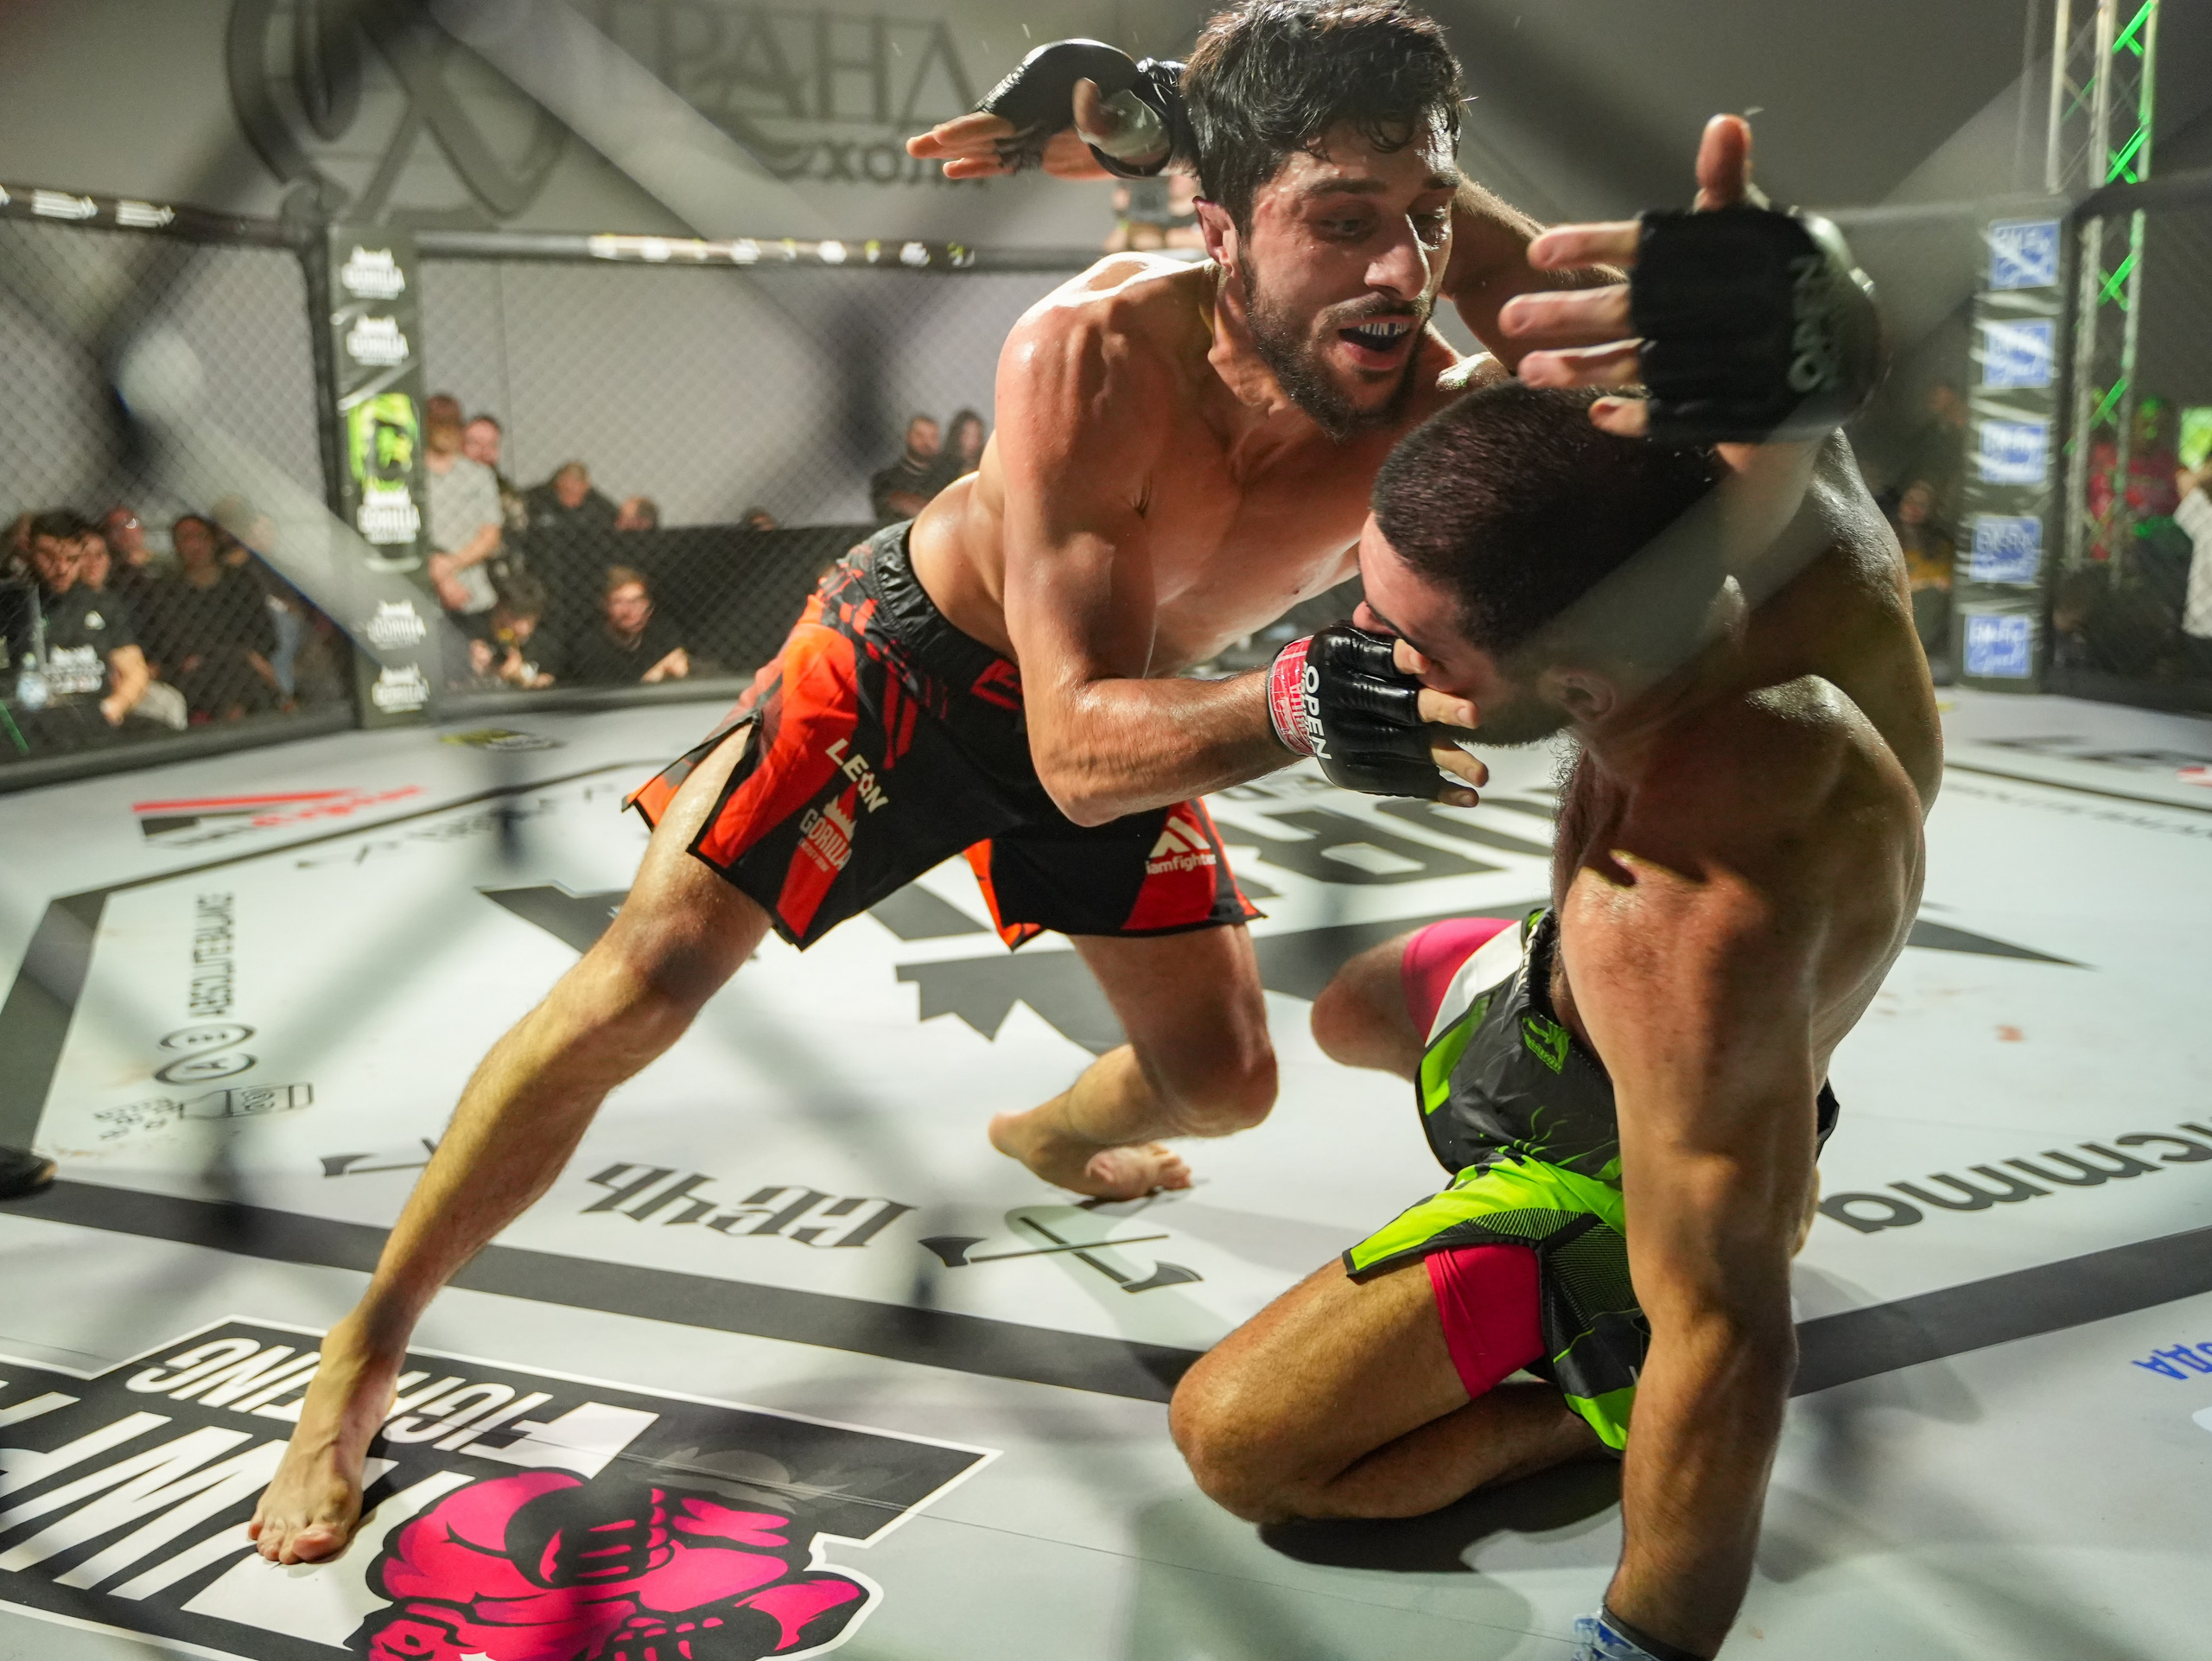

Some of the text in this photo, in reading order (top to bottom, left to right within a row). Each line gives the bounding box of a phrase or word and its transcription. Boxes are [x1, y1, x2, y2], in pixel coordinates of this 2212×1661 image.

[1304, 665, 1332, 760] OPEN
[825, 737, 889, 814] LEON
[799, 808, 853, 872] GORILLA
